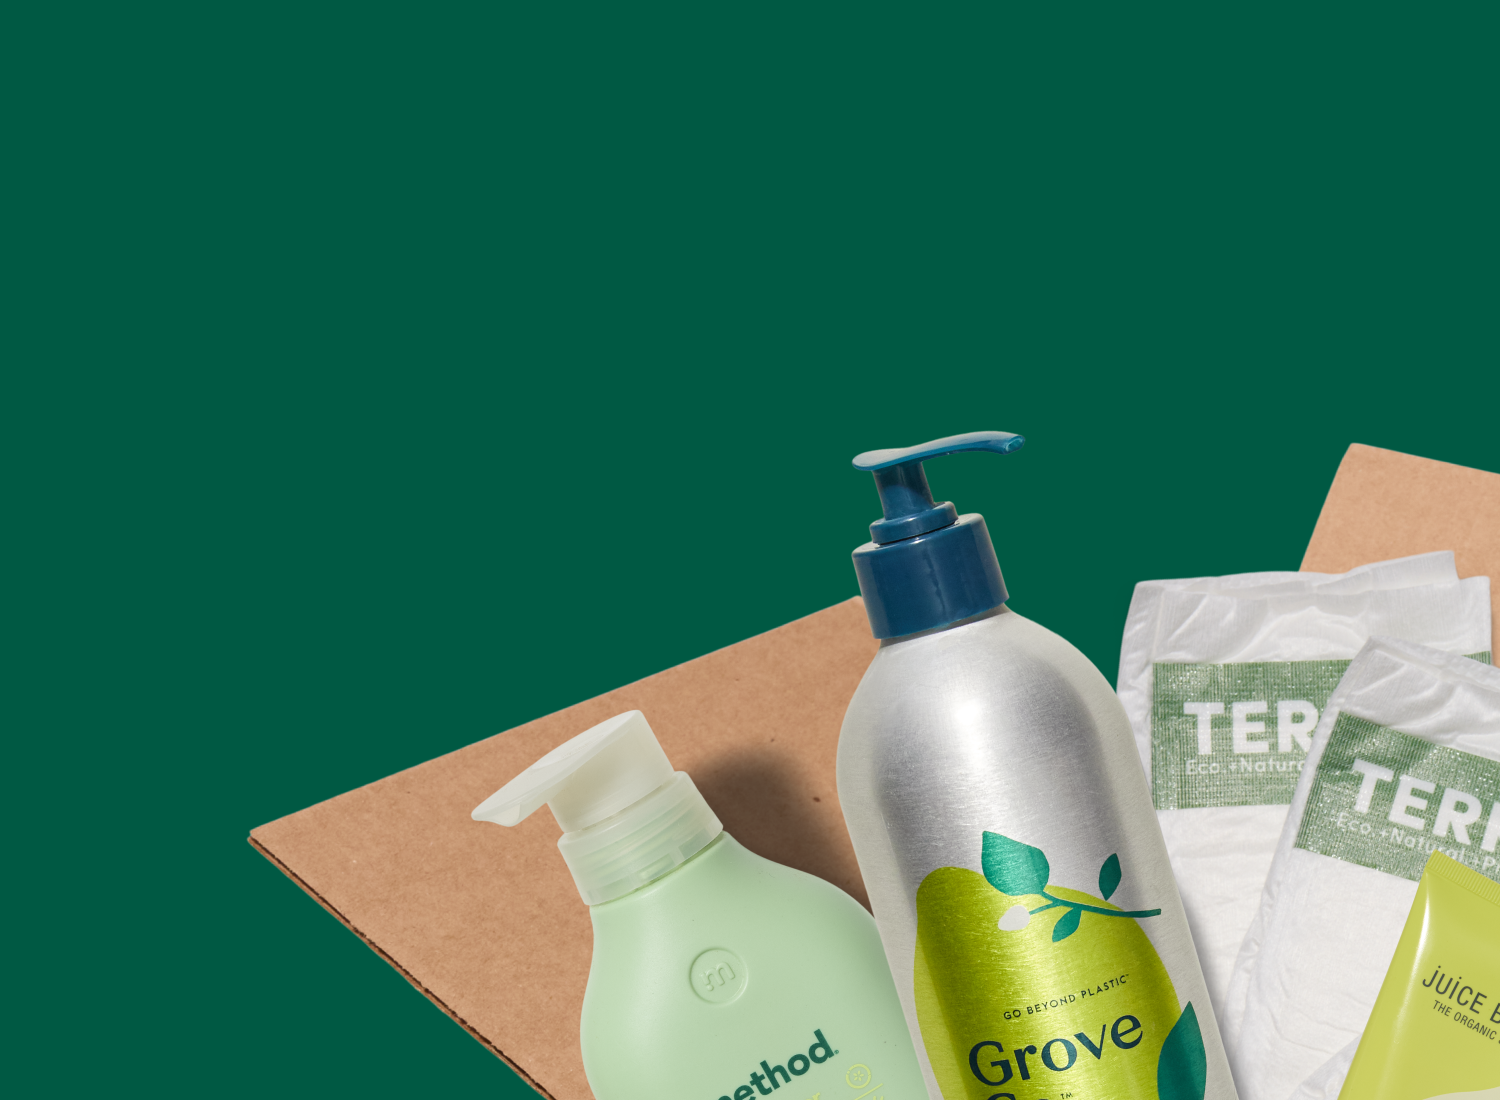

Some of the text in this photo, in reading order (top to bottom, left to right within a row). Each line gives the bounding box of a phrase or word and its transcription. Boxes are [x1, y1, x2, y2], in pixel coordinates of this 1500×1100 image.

[1184, 700, 1318, 755] TER
[1003, 1009, 1021, 1019] GO
[1027, 994, 1076, 1015] BEYOND
[1433, 1000, 1452, 1017] THE
[1453, 1011, 1497, 1040] ORGANIC
[968, 1014, 1143, 1086] Grove
